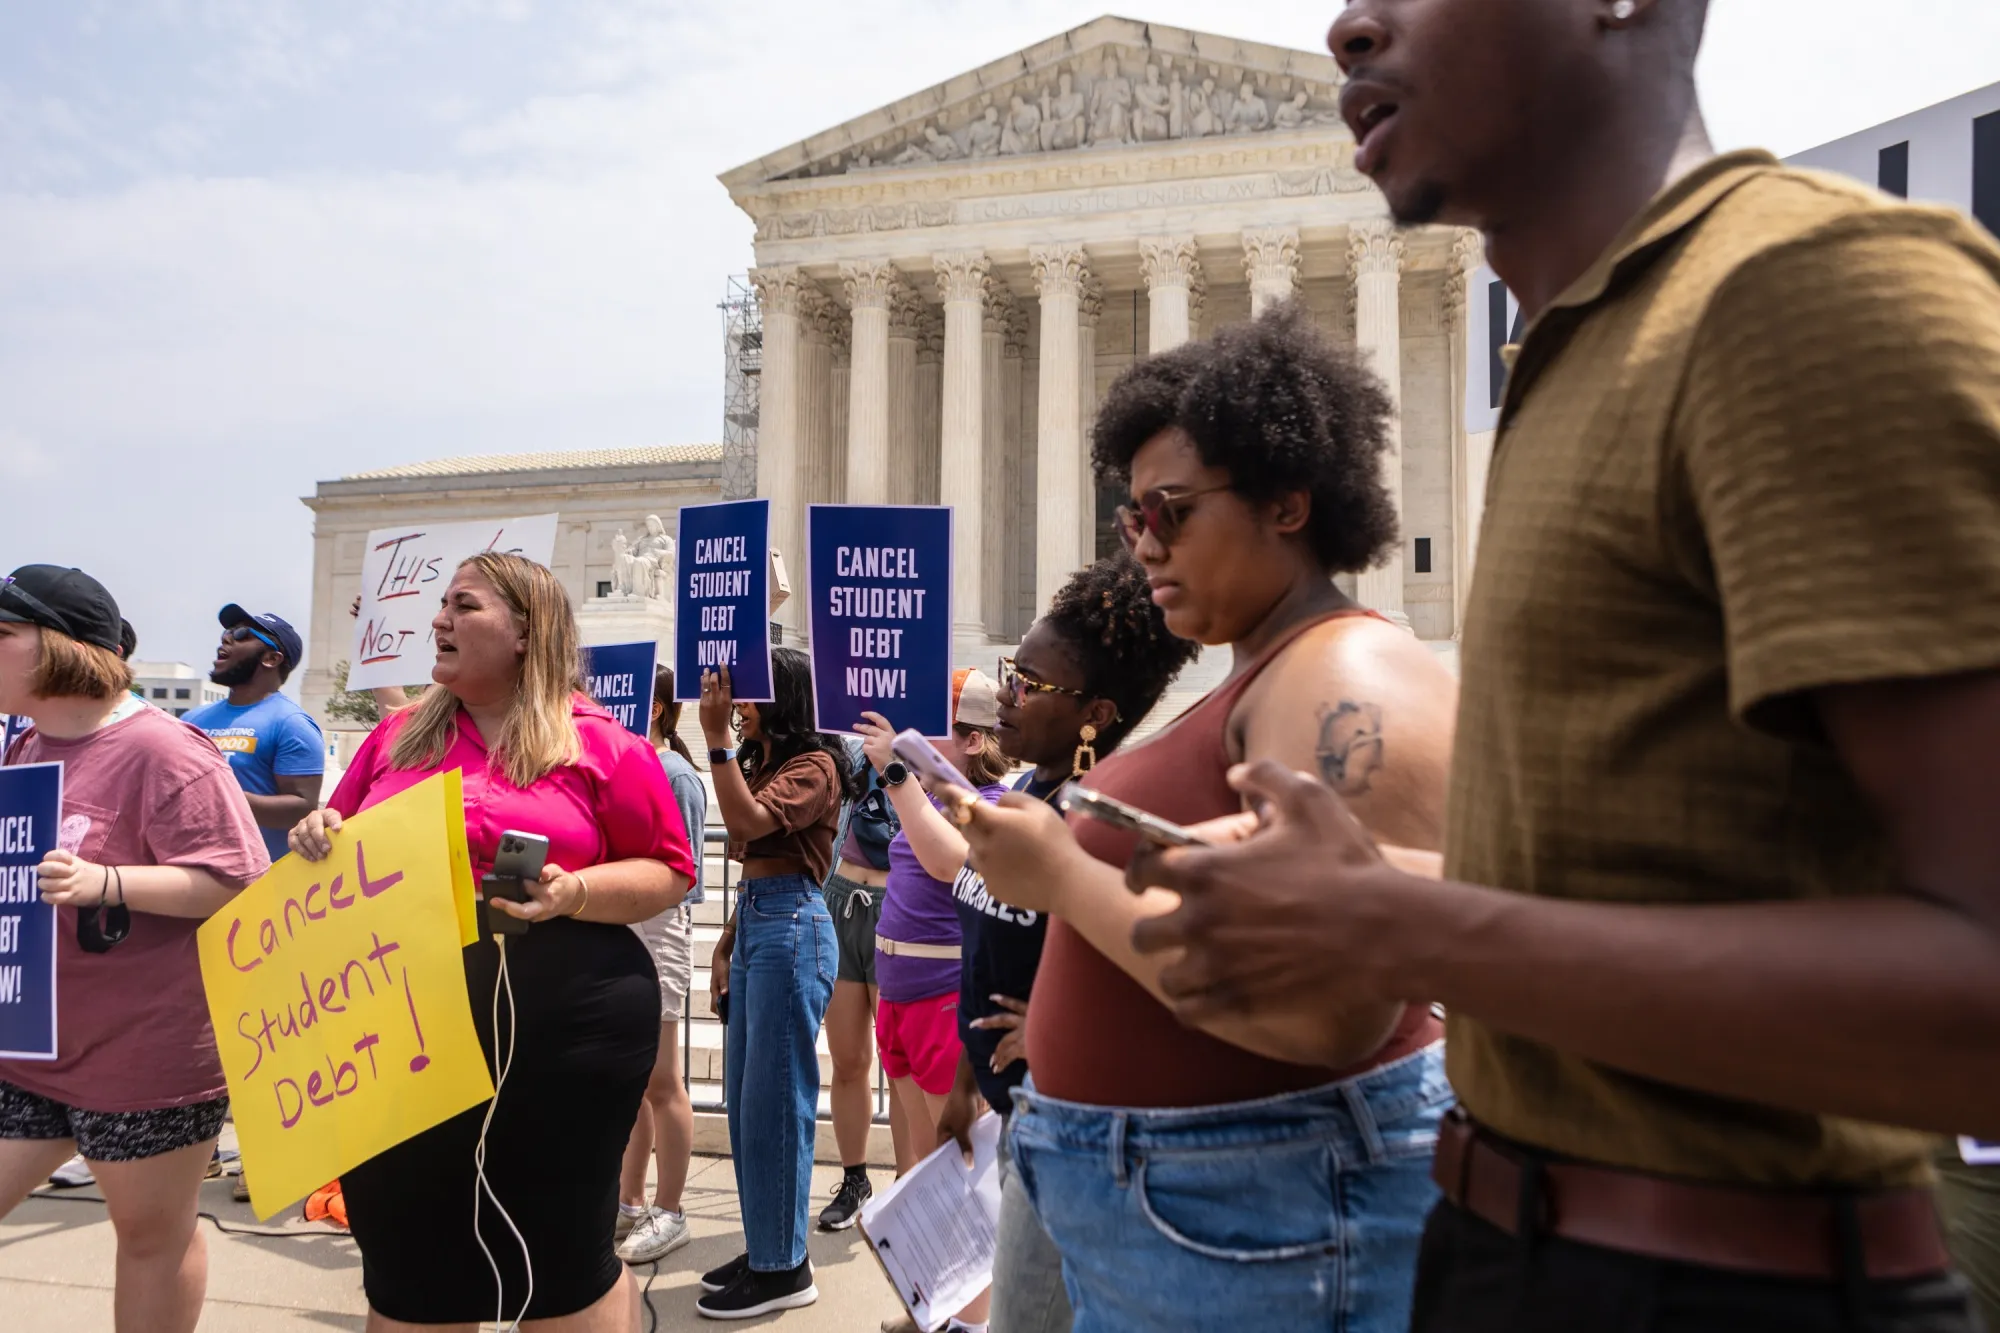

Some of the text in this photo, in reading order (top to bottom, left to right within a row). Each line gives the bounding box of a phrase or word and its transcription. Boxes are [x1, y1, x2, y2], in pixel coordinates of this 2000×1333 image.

[973, 182, 1255, 221] EQUAL JUSTICE UNDER LAW
[695, 536, 747, 565] CANCEL
[836, 546, 919, 579] CANCEL
[690, 570, 751, 598] STUDENT
[701, 605, 736, 632] DEBT
[830, 586, 926, 619] STUDENT
[360, 617, 415, 656] NOT
[850, 627, 903, 659] DEBT
[698, 640, 737, 666] NOW!
[585, 674, 635, 699] CANCEL
[846, 667, 906, 699] NOW!
